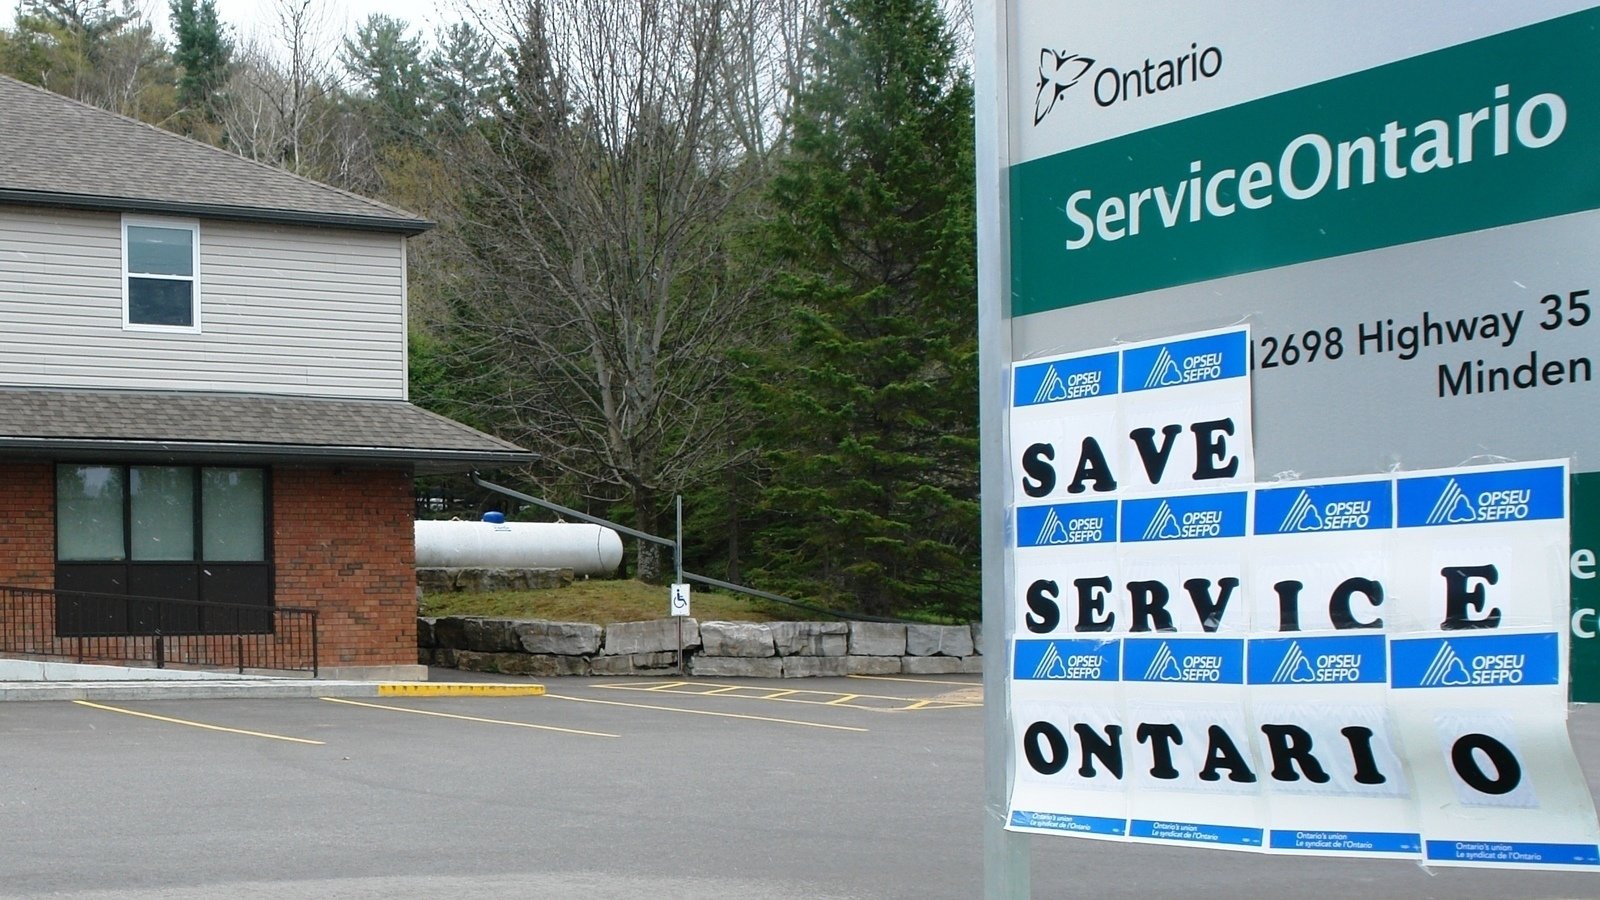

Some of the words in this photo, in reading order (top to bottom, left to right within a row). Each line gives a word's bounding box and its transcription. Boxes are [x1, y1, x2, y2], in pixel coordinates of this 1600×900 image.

[1094, 43, 1222, 107] Ontario
[1066, 84, 1567, 250] ServiceOntario
[1358, 310, 1524, 360] Highway
[1539, 290, 1591, 330] 35
[1183, 352, 1222, 370] OPSEU
[1068, 371, 1101, 386] OPSEU
[1182, 366, 1221, 382] SEFPO
[1438, 351, 1592, 397] Minden
[1067, 384, 1100, 399] SEFPO
[1022, 418, 1239, 498] SAVE
[1478, 489, 1530, 506] OPSEU
[1325, 500, 1371, 515] OPSEU
[1477, 505, 1528, 521] SEFPO
[1069, 517, 1103, 530] OPSEU
[1183, 511, 1222, 525] OPSEU
[1323, 515, 1369, 529] SEFPO
[1068, 529, 1102, 543] SEFPO
[1181, 523, 1220, 538] SEFPO
[1026, 564, 1501, 633] SERVICE
[1068, 655, 1102, 667] OPSEU
[1183, 656, 1222, 669] OPSEU
[1317, 654, 1361, 668] OPSEU
[1472, 654, 1525, 669] OPSEU
[1067, 667, 1100, 679] SEFPO
[1181, 669, 1220, 681] SEFPO
[1316, 668, 1359, 682] SEFPO
[1471, 669, 1522, 684] SEFPO
[1296, 831, 1327, 840] Ontario's
[1305, 840, 1332, 849] syndicat
[1343, 841, 1373, 849] l'Ontario
[1456, 842, 1489, 851] Ontario's
[1466, 851, 1496, 860] syndicat
[1508, 852, 1541, 860] l'Ontario
